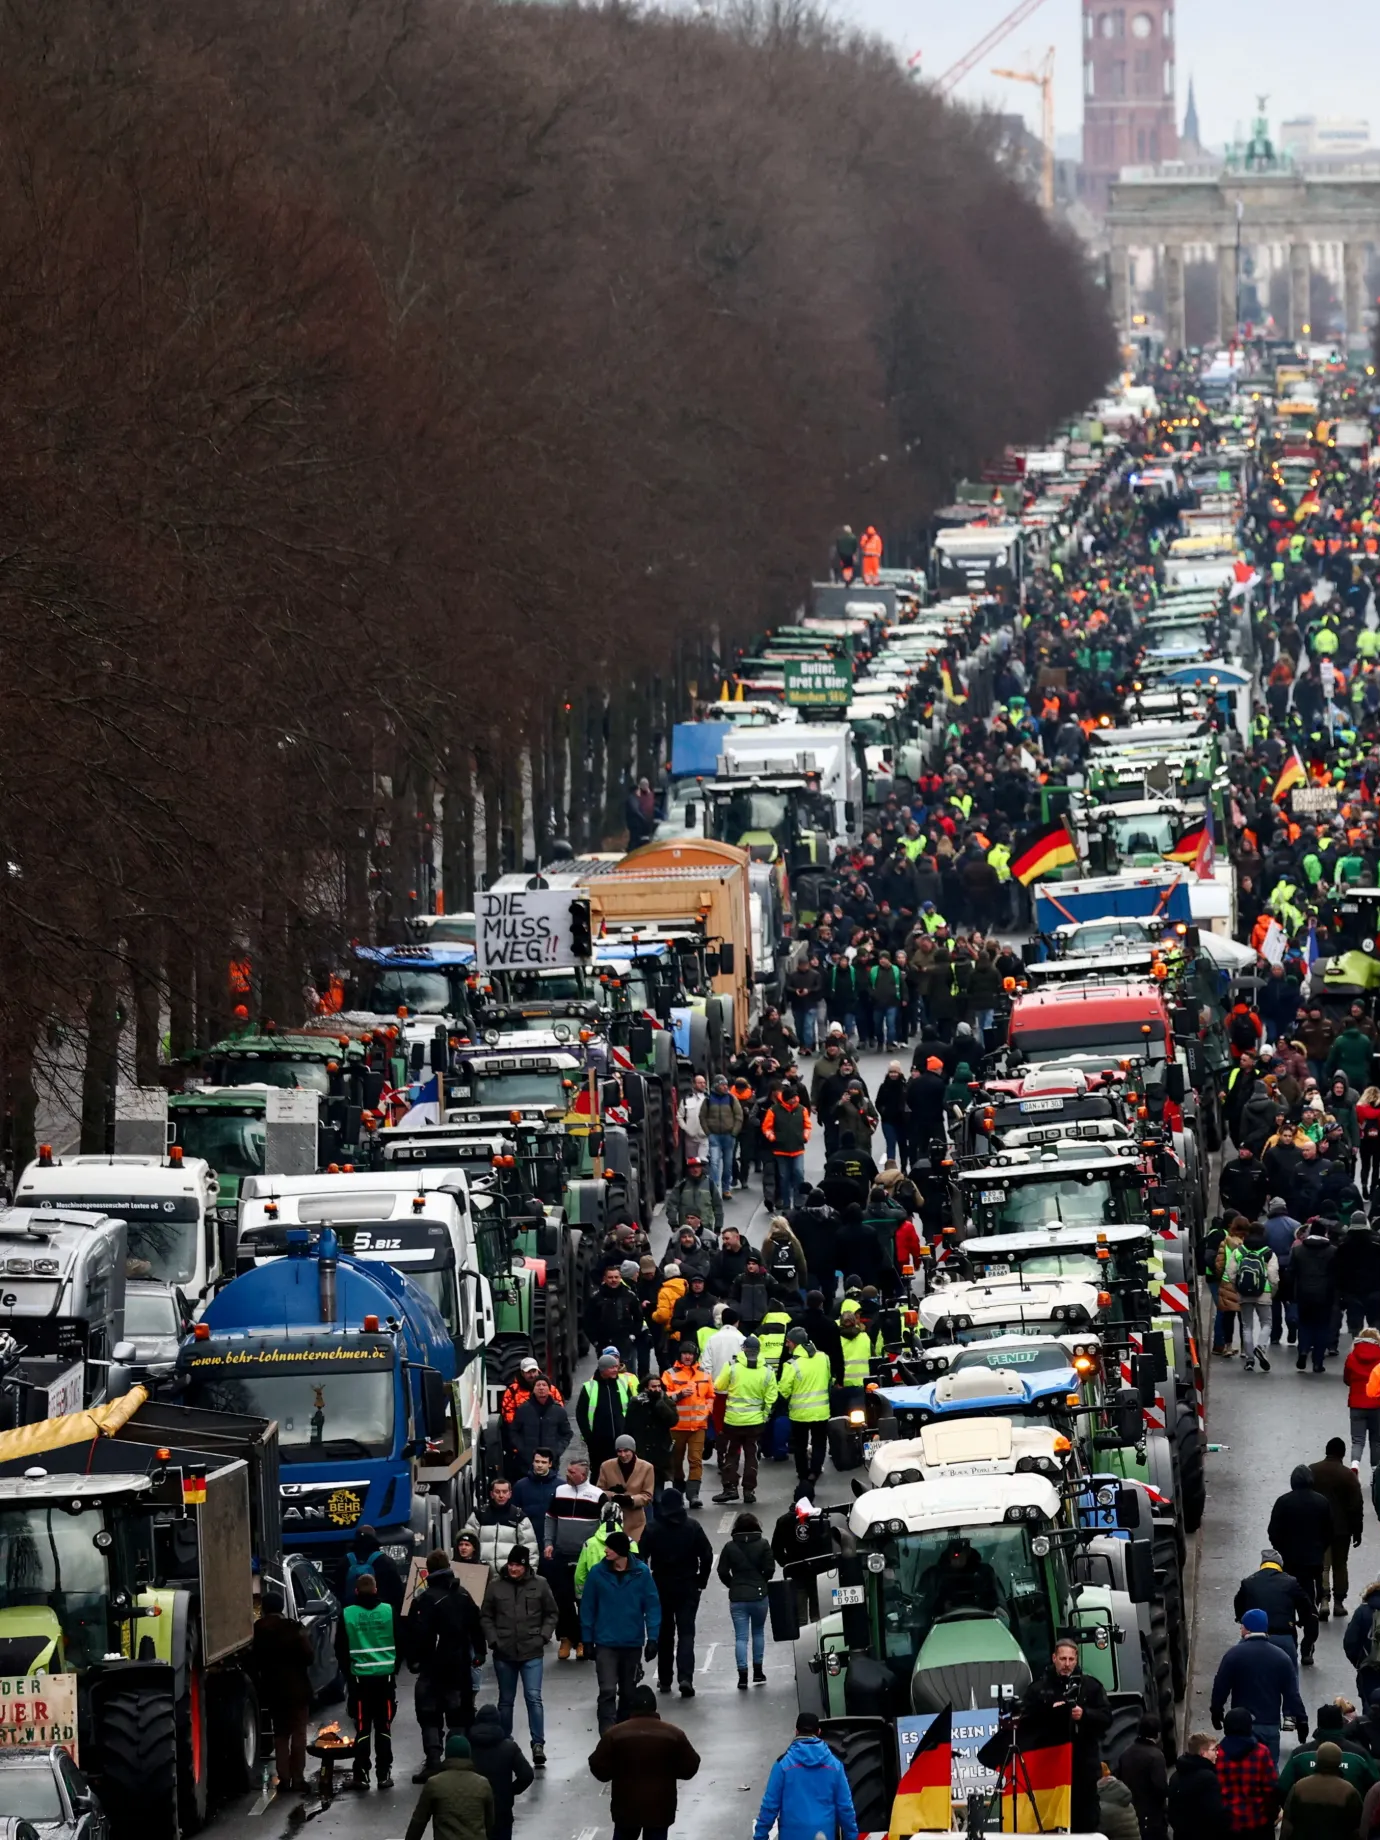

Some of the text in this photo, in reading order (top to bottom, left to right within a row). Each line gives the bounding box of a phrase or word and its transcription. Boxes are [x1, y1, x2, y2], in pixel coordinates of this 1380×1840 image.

[482, 893, 527, 916] DIE
[483, 916, 551, 939] MUSS
[484, 936, 559, 965] WEG!!
[987, 1350, 1039, 1365] FENDT
[329, 1502, 361, 1512] BEHR
[844, 1595, 859, 1604] 930
[901, 1731, 919, 1744] ES
